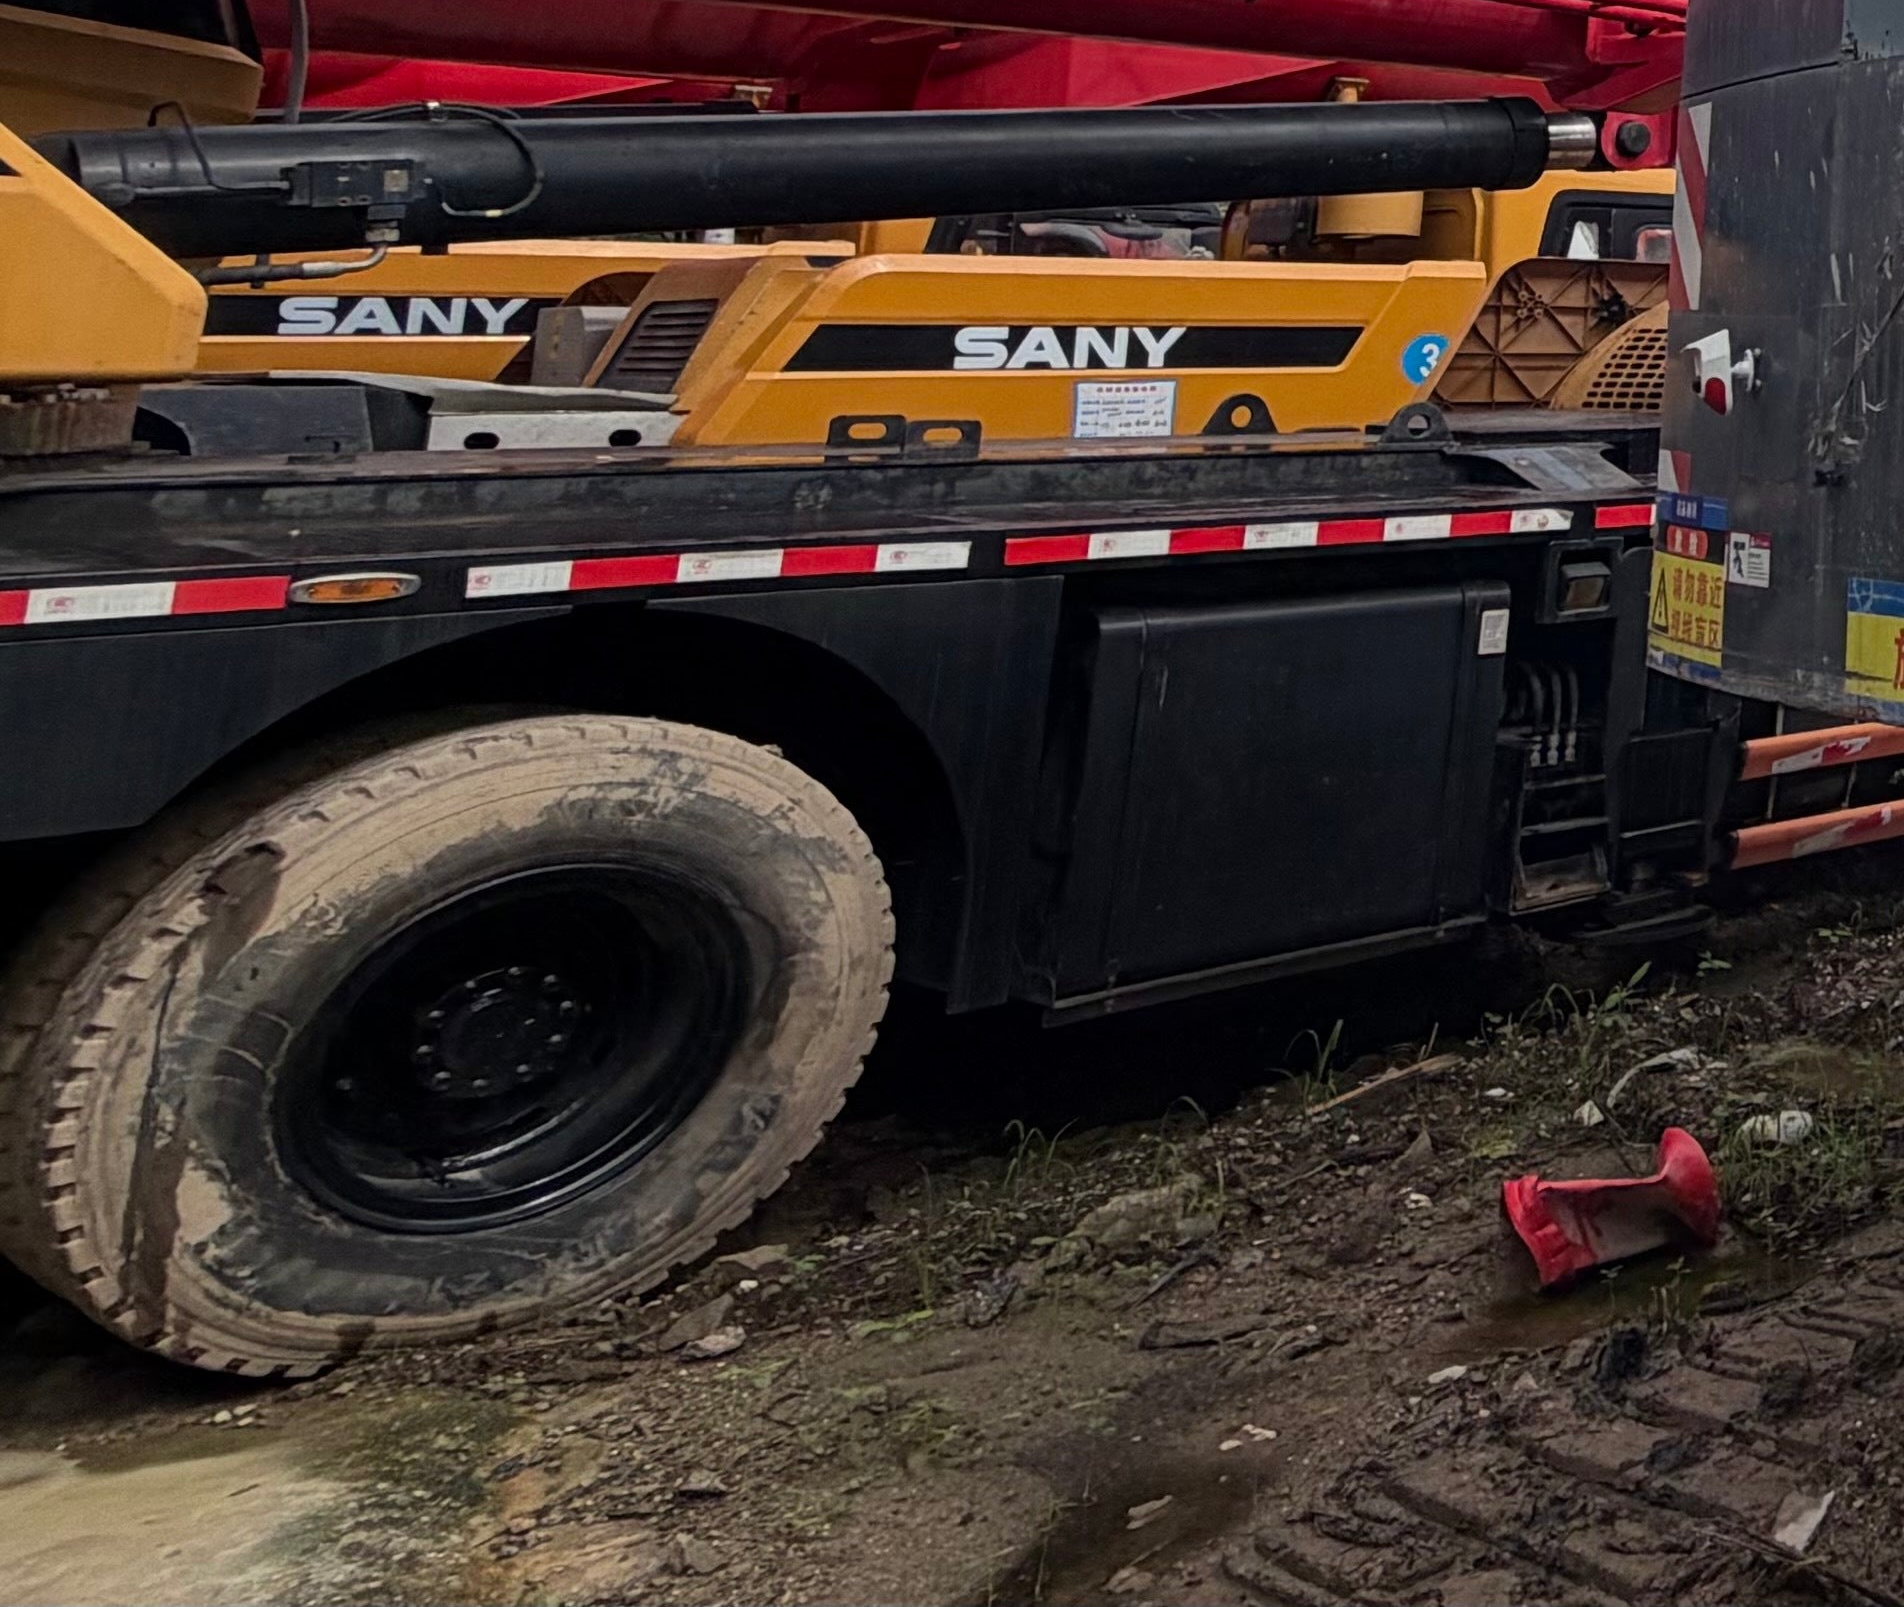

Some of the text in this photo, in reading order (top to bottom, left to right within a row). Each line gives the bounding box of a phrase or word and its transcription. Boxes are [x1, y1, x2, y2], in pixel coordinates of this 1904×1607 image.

[279, 297, 529, 336] SANY
[953, 326, 1187, 369] SANY
[1420, 343, 1440, 377] 3
